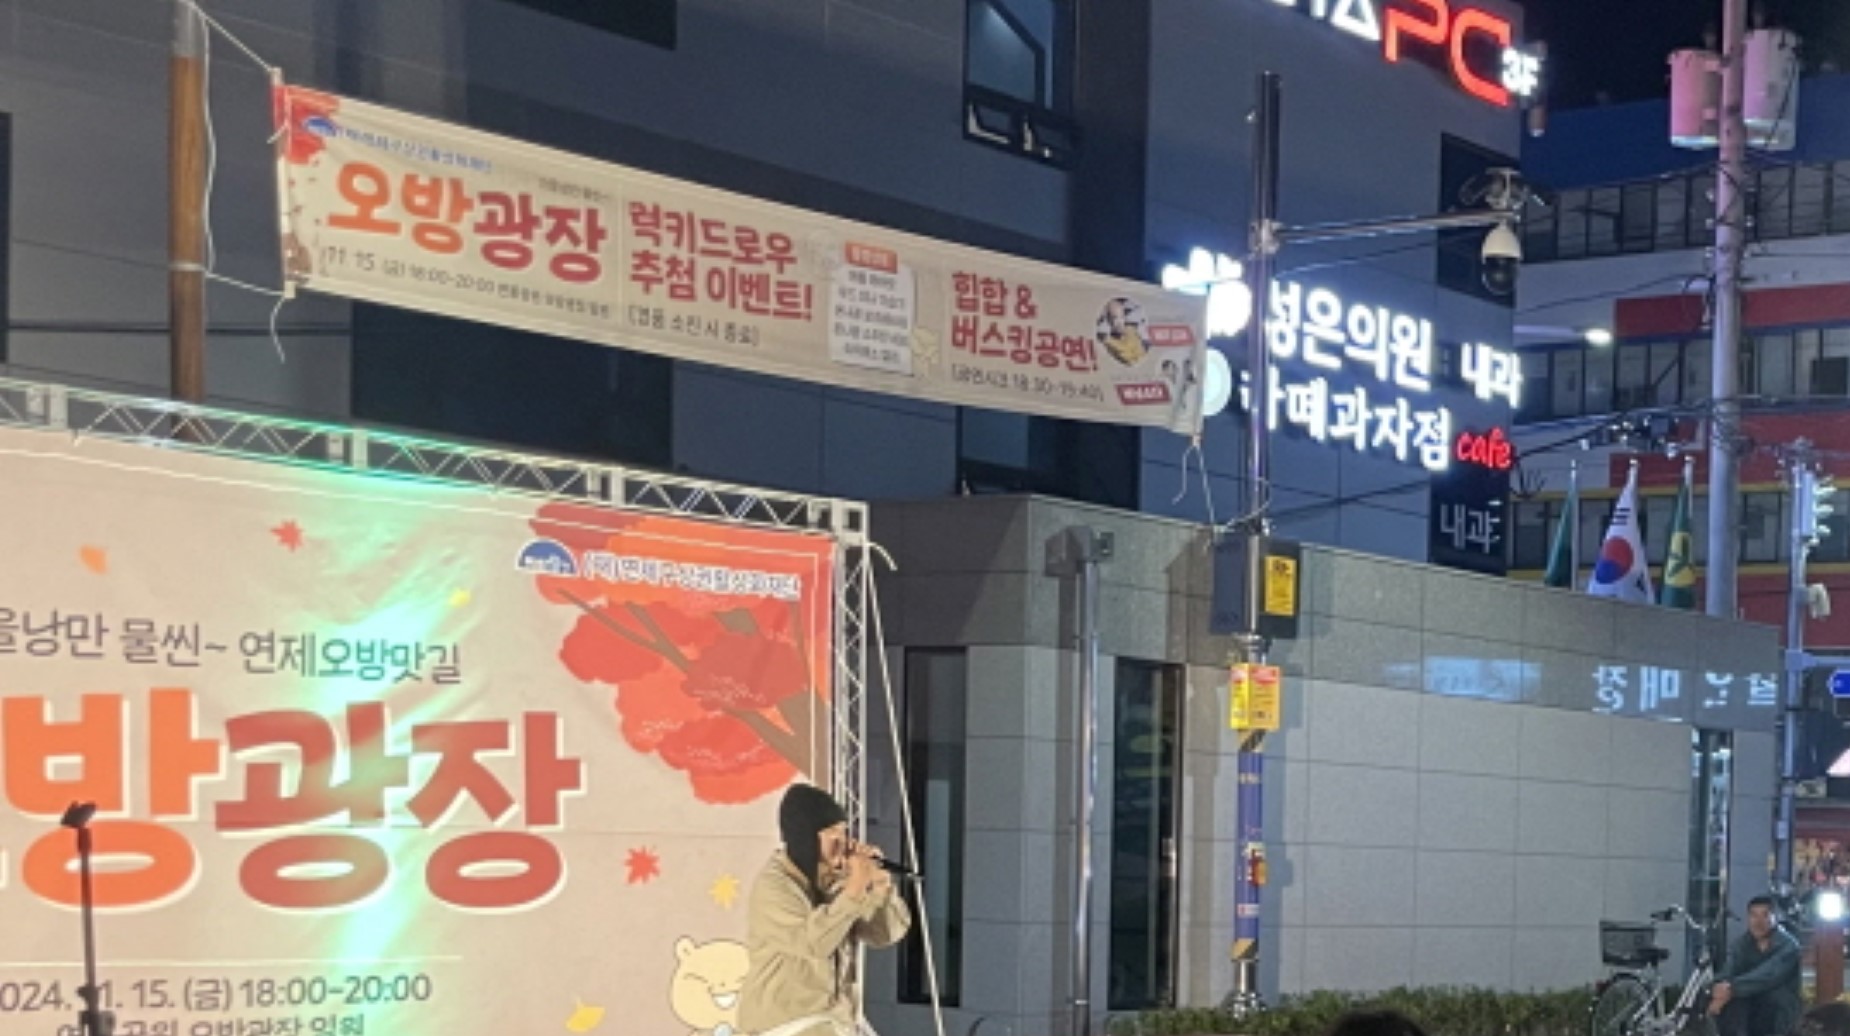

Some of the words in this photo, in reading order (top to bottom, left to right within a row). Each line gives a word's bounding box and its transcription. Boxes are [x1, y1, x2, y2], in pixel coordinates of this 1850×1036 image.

[328, 161, 607, 283] 오방광장
[629, 201, 798, 275] 럭키드로우
[630, 249, 698, 301] 추첨
[706, 266, 813, 322] 이벤트!
[951, 271, 1008, 317] 힙합
[1014, 283, 1038, 319] &
[951, 315, 1099, 372] 버스킹공연!
[1461, 341, 1524, 409] 내과
[1456, 427, 1513, 471] cafe
[1440, 503, 1491, 554] 내과
[239, 629, 462, 684] 연제오방맛길
[130, 978, 176, 1009] 15.
[184, 975, 233, 1012] (금)
[241, 973, 432, 1009] 18:00-20:00
